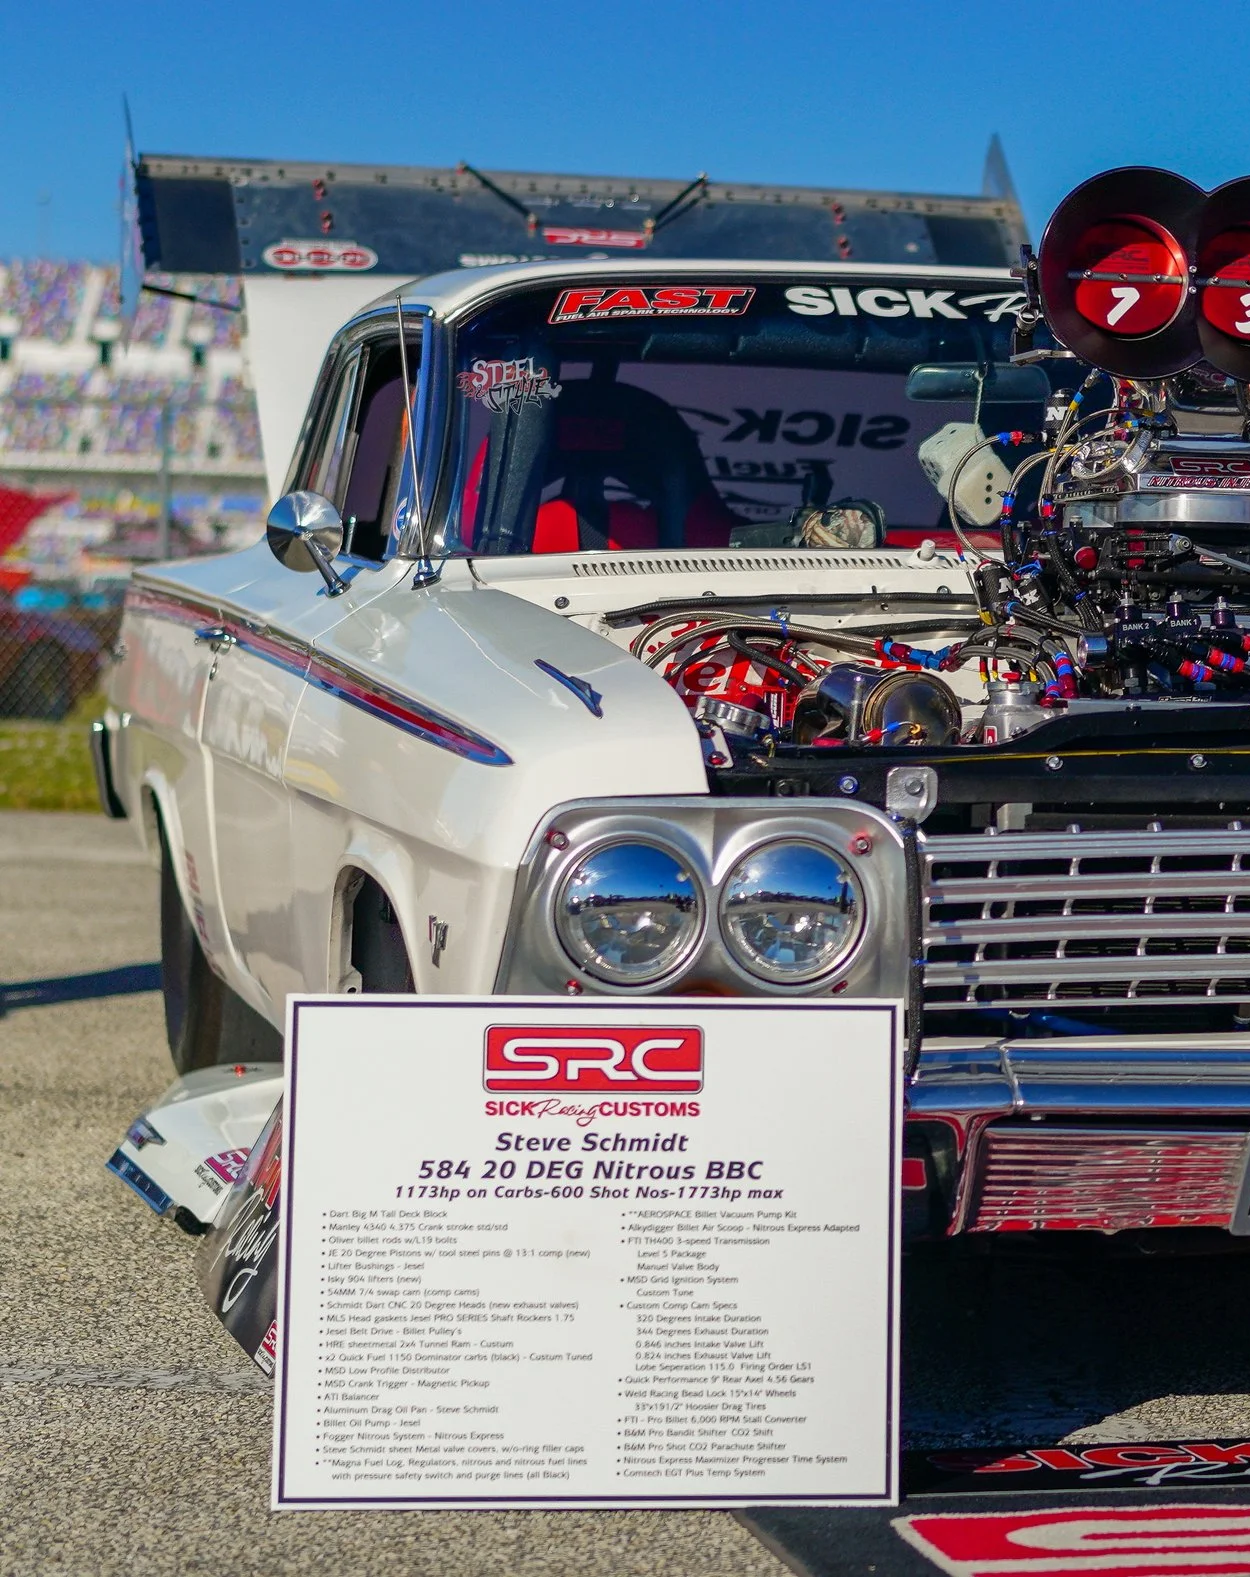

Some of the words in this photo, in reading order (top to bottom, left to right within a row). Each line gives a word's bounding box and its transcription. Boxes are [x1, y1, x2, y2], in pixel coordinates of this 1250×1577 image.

[560, 289, 748, 314] FAST
[785, 287, 967, 318] SICK
[1106, 287, 1141, 326] 7
[556, 313, 584, 321] FUEL
[472, 357, 544, 388] STEEL
[487, 376, 552, 415] STYLE
[1148, 476, 1216, 488] NITROUS
[1122, 623, 1144, 631] BANK
[1171, 619, 1192, 627] BANK
[486, 1038, 702, 1081] SRC
[484, 1101, 535, 1117] SICK
[533, 1098, 601, 1127] Racing
[598, 1100, 700, 1117] CUSTOMS
[495, 1132, 571, 1151] Steve
[581, 1132, 688, 1152] Schmidt
[418, 1160, 470, 1179] 584
[480, 1160, 516, 1179] 20
[525, 1160, 583, 1179] DEG
[592, 1160, 695, 1180] Nitrous
[705, 1160, 763, 1180] BBC
[396, 1185, 460, 1199] 1173hp
[466, 1188, 487, 1198] on
[494, 1185, 584, 1198] Carbs-600
[589, 1186, 630, 1198] Shot
[635, 1186, 742, 1198] Nos-1773hp
[747, 1189, 784, 1198] max
[329, 1210, 348, 1218] Dart
[351, 1210, 366, 1220] Big
[380, 1210, 396, 1218] Tall
[670, 1250, 706, 1259] Package
[636, 1288, 670, 1296] Custom
[672, 1288, 694, 1296] Tune
[324, 1366, 346, 1374] MSD
[370, 1366, 400, 1374] Profile
[402, 1366, 450, 1374] Distributor
[323, 1392, 338, 1400] ATI
[664, 1468, 682, 1476] EGT
[685, 1468, 703, 1477] Plus
[706, 1468, 731, 1477] Temp
[733, 1469, 765, 1477] System
